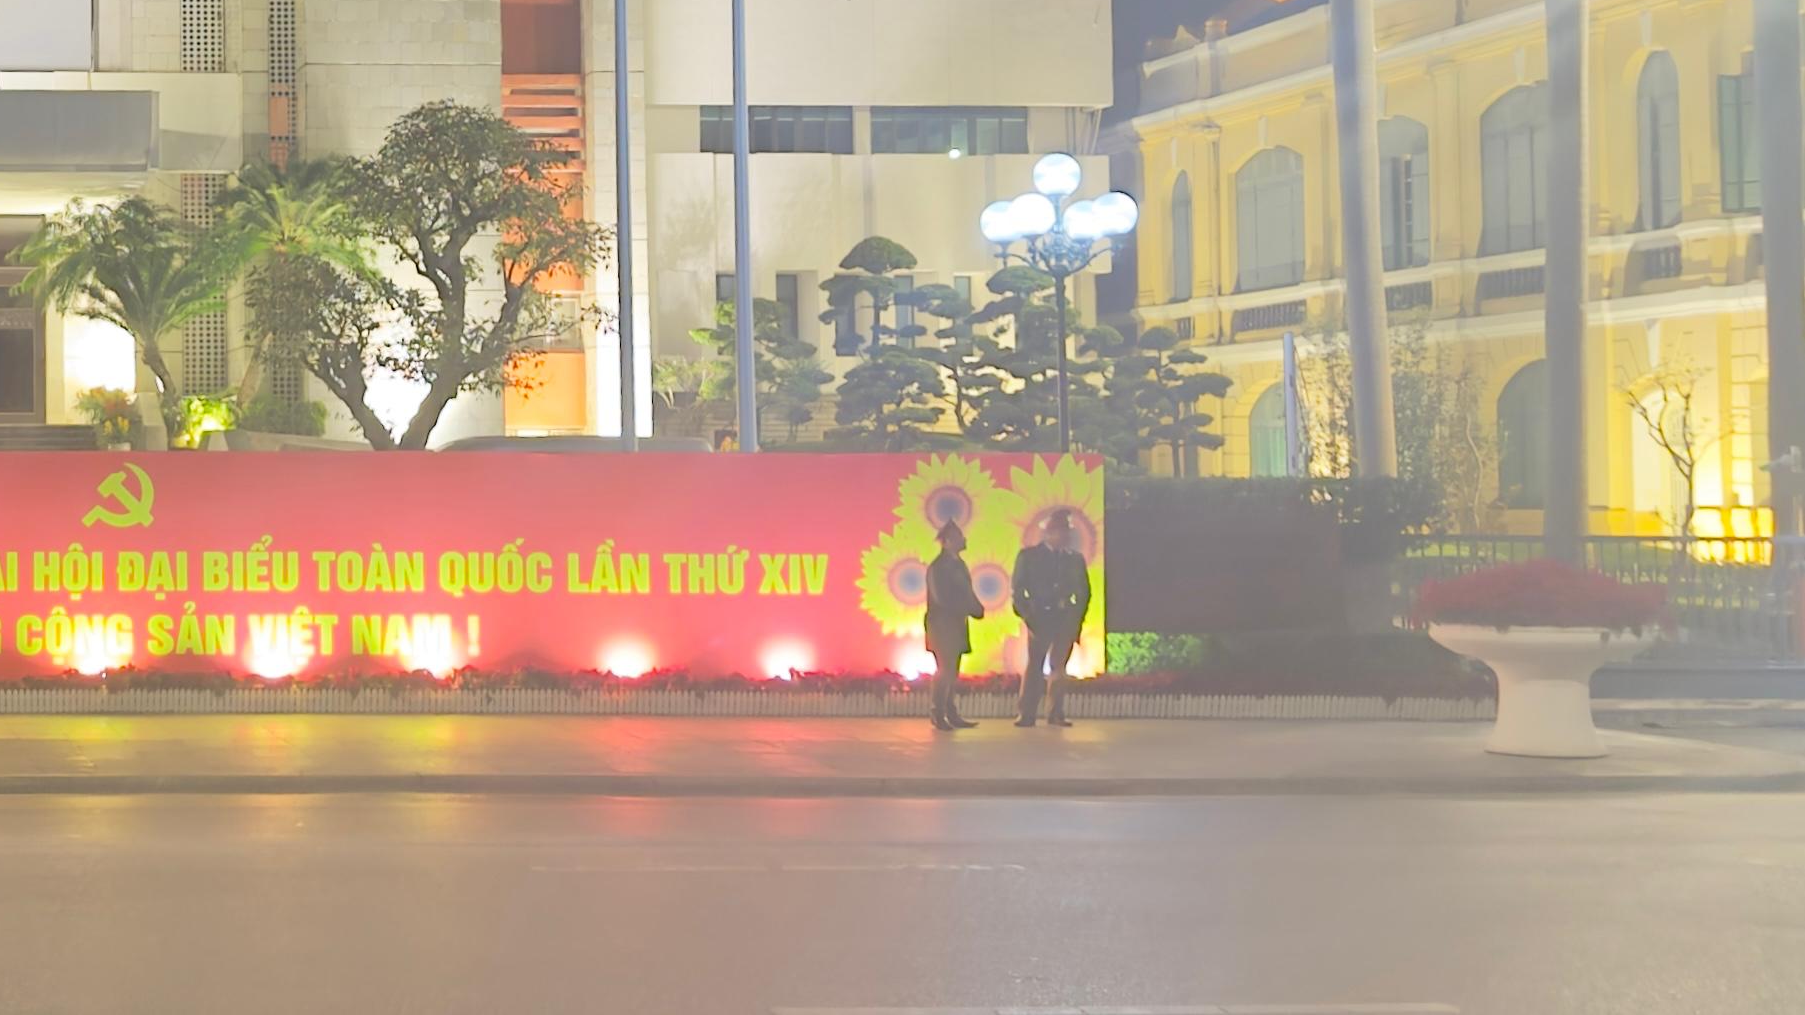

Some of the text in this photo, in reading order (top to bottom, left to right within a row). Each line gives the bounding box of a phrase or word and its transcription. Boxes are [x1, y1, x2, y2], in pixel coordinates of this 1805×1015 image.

[33, 543, 104, 601] HỘI
[116, 551, 188, 601] ĐẠI
[203, 534, 300, 593] BIỂU
[311, 542, 425, 593] TOÀN
[438, 538, 554, 597] QUỐC
[567, 539, 650, 594] LẦN
[663, 545, 750, 595] THỨ
[758, 553, 829, 595] XIV
[16, 605, 134, 666] CỘNG
[147, 601, 236, 656] SẢN
[351, 613, 453, 656] NAM
[467, 614, 481, 657] !
